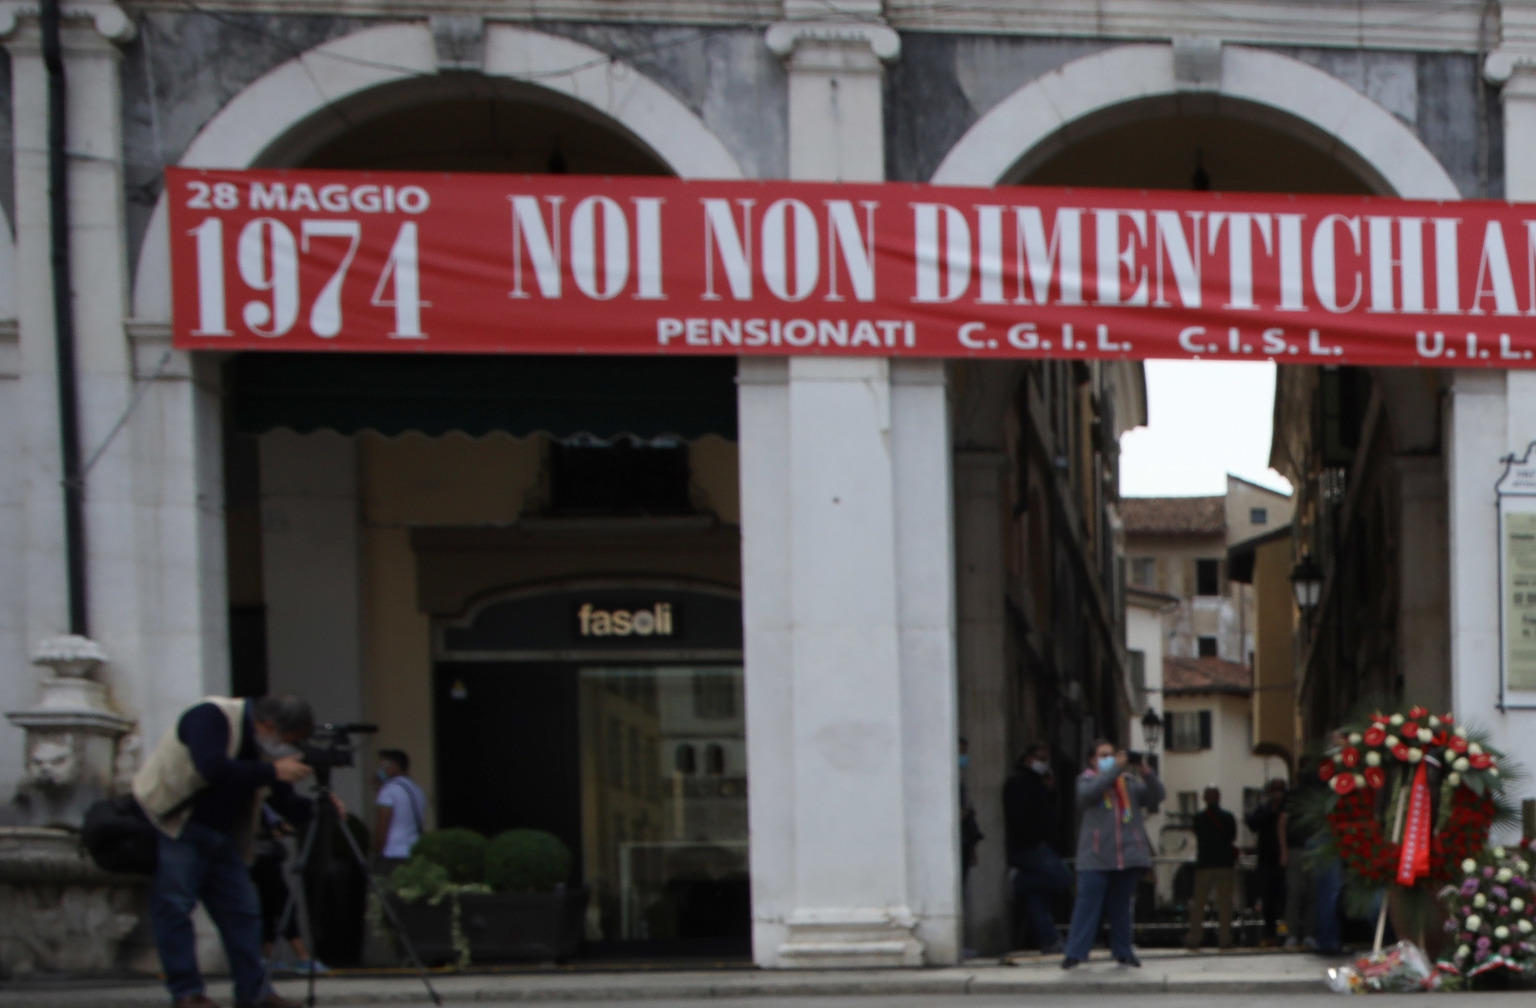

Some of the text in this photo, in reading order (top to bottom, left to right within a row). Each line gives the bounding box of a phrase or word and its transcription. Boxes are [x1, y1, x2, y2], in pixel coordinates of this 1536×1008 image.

[185, 181, 431, 214] 28 MAGGIO
[507, 194, 668, 300] NOI
[700, 198, 881, 303] NON
[185, 216, 432, 340] 1974
[656, 318, 916, 348] PENSIONATI
[578, 603, 672, 636] fasoli
